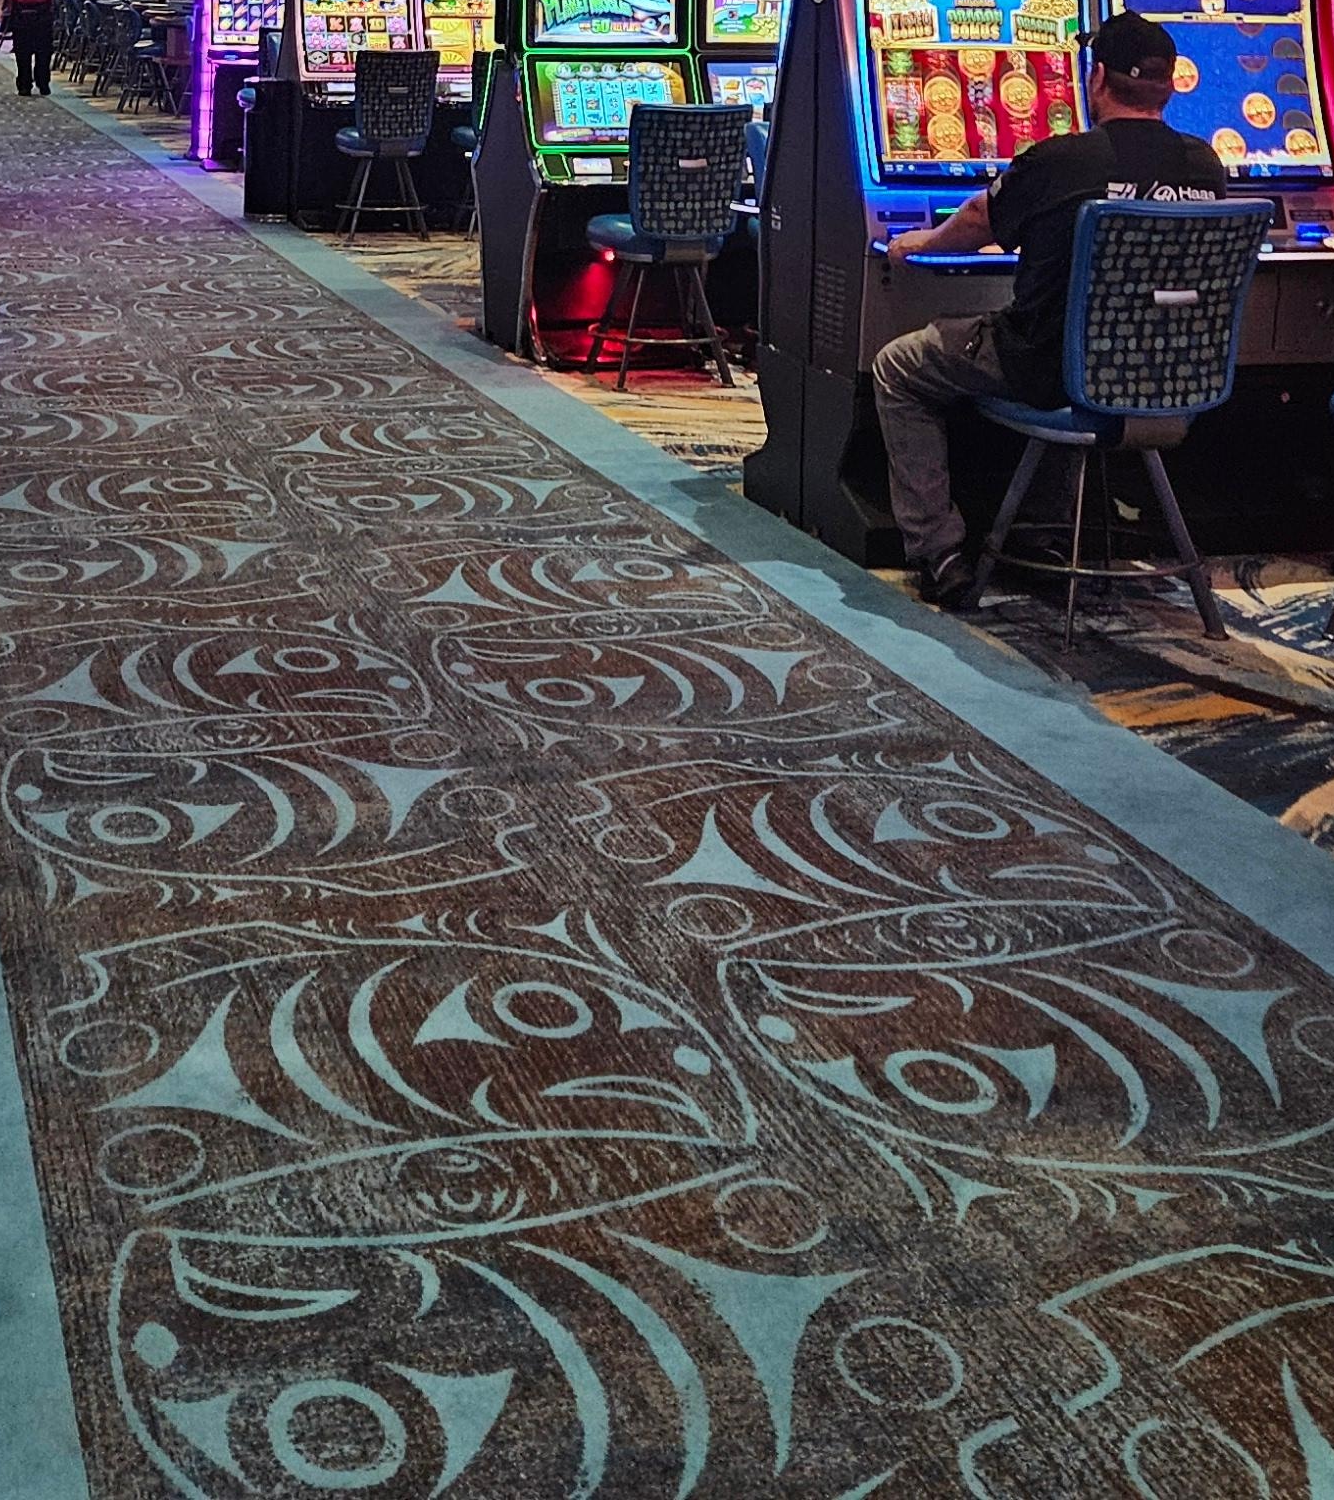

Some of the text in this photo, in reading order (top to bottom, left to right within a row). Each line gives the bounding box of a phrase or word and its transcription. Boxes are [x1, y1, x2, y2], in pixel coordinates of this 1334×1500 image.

[591, 19, 611, 33] 50
[951, 23, 1001, 42] BONUS
[1178, 185, 1216, 200] Haas
